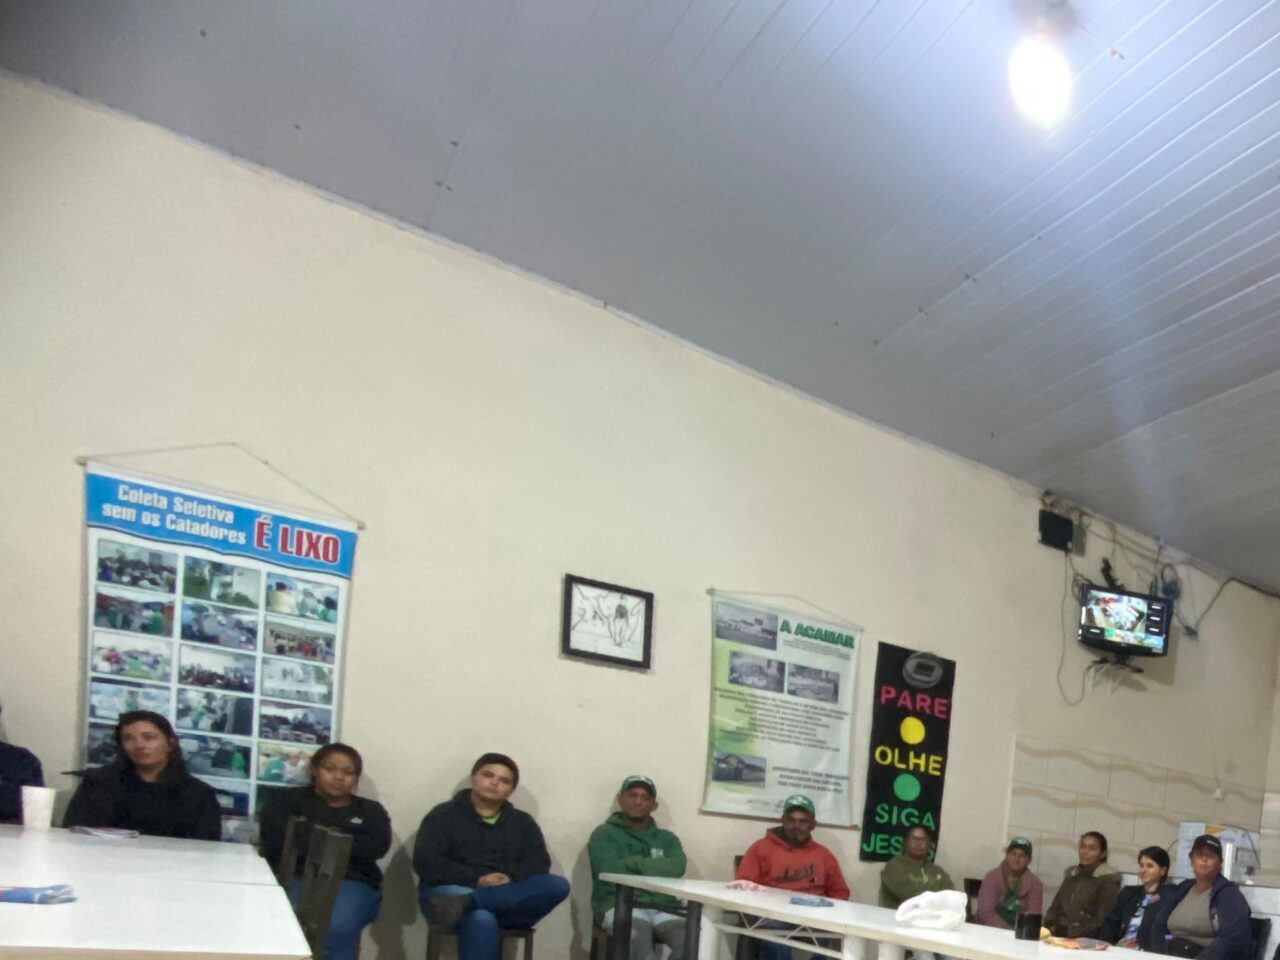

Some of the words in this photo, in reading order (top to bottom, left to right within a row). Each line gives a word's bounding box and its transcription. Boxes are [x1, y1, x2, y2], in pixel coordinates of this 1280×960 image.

[118, 484, 168, 510] Coleta
[173, 497, 235, 524] Seletiva
[102, 503, 136, 522] sem
[141, 511, 160, 528] os
[166, 514, 247, 545] Catadores
[255, 513, 272, 551] É
[280, 524, 341, 564] LIXO
[780, 619, 792, 634] A
[880, 685, 949, 719] PARE
[874, 745, 943, 776] OLHE
[875, 803, 936, 831] SIGA
[862, 833, 935, 861] JESS
